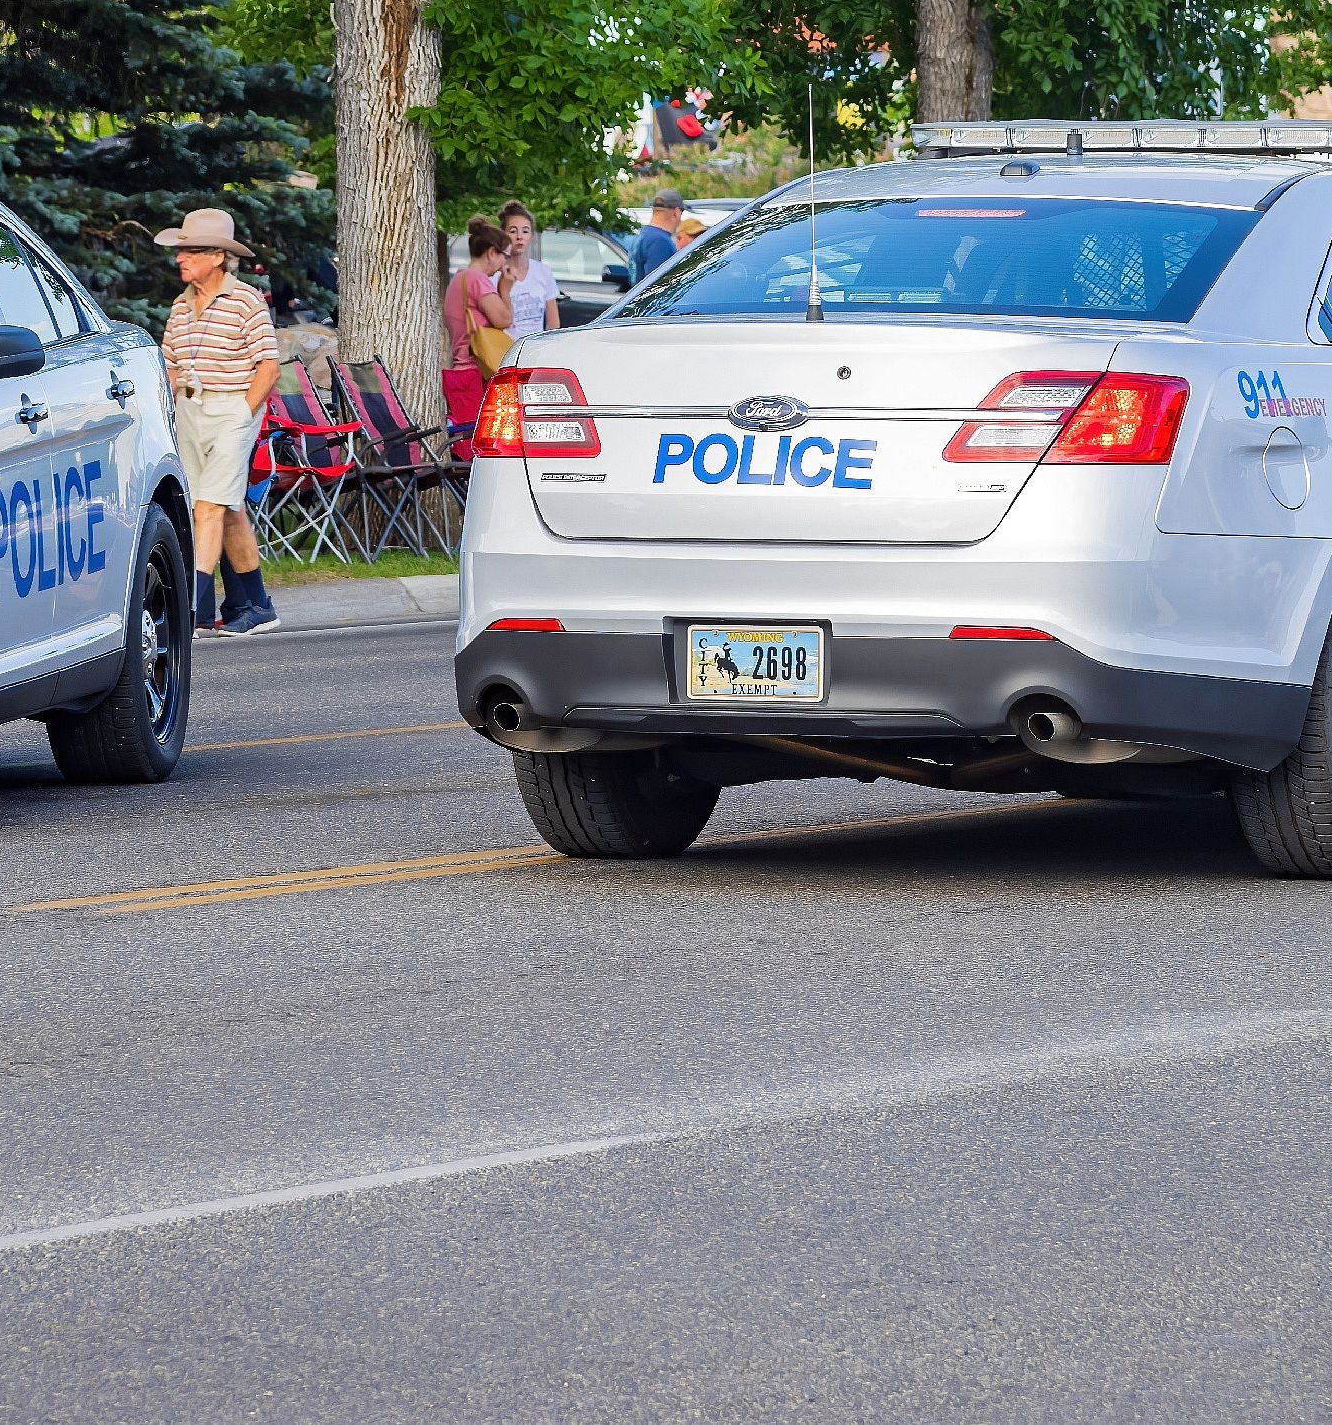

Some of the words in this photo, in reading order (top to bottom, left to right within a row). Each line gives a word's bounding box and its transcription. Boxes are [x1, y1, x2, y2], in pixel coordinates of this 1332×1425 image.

[1238, 370, 1291, 419] 911
[1259, 397, 1327, 417] EMERGENCY
[745, 400, 784, 418] Ford
[653, 432, 878, 490] POLICE
[727, 632, 785, 643] WYOMING
[699, 637, 709, 688] CITY
[752, 646, 807, 681] 2698
[731, 683, 778, 696] EXEMPT
